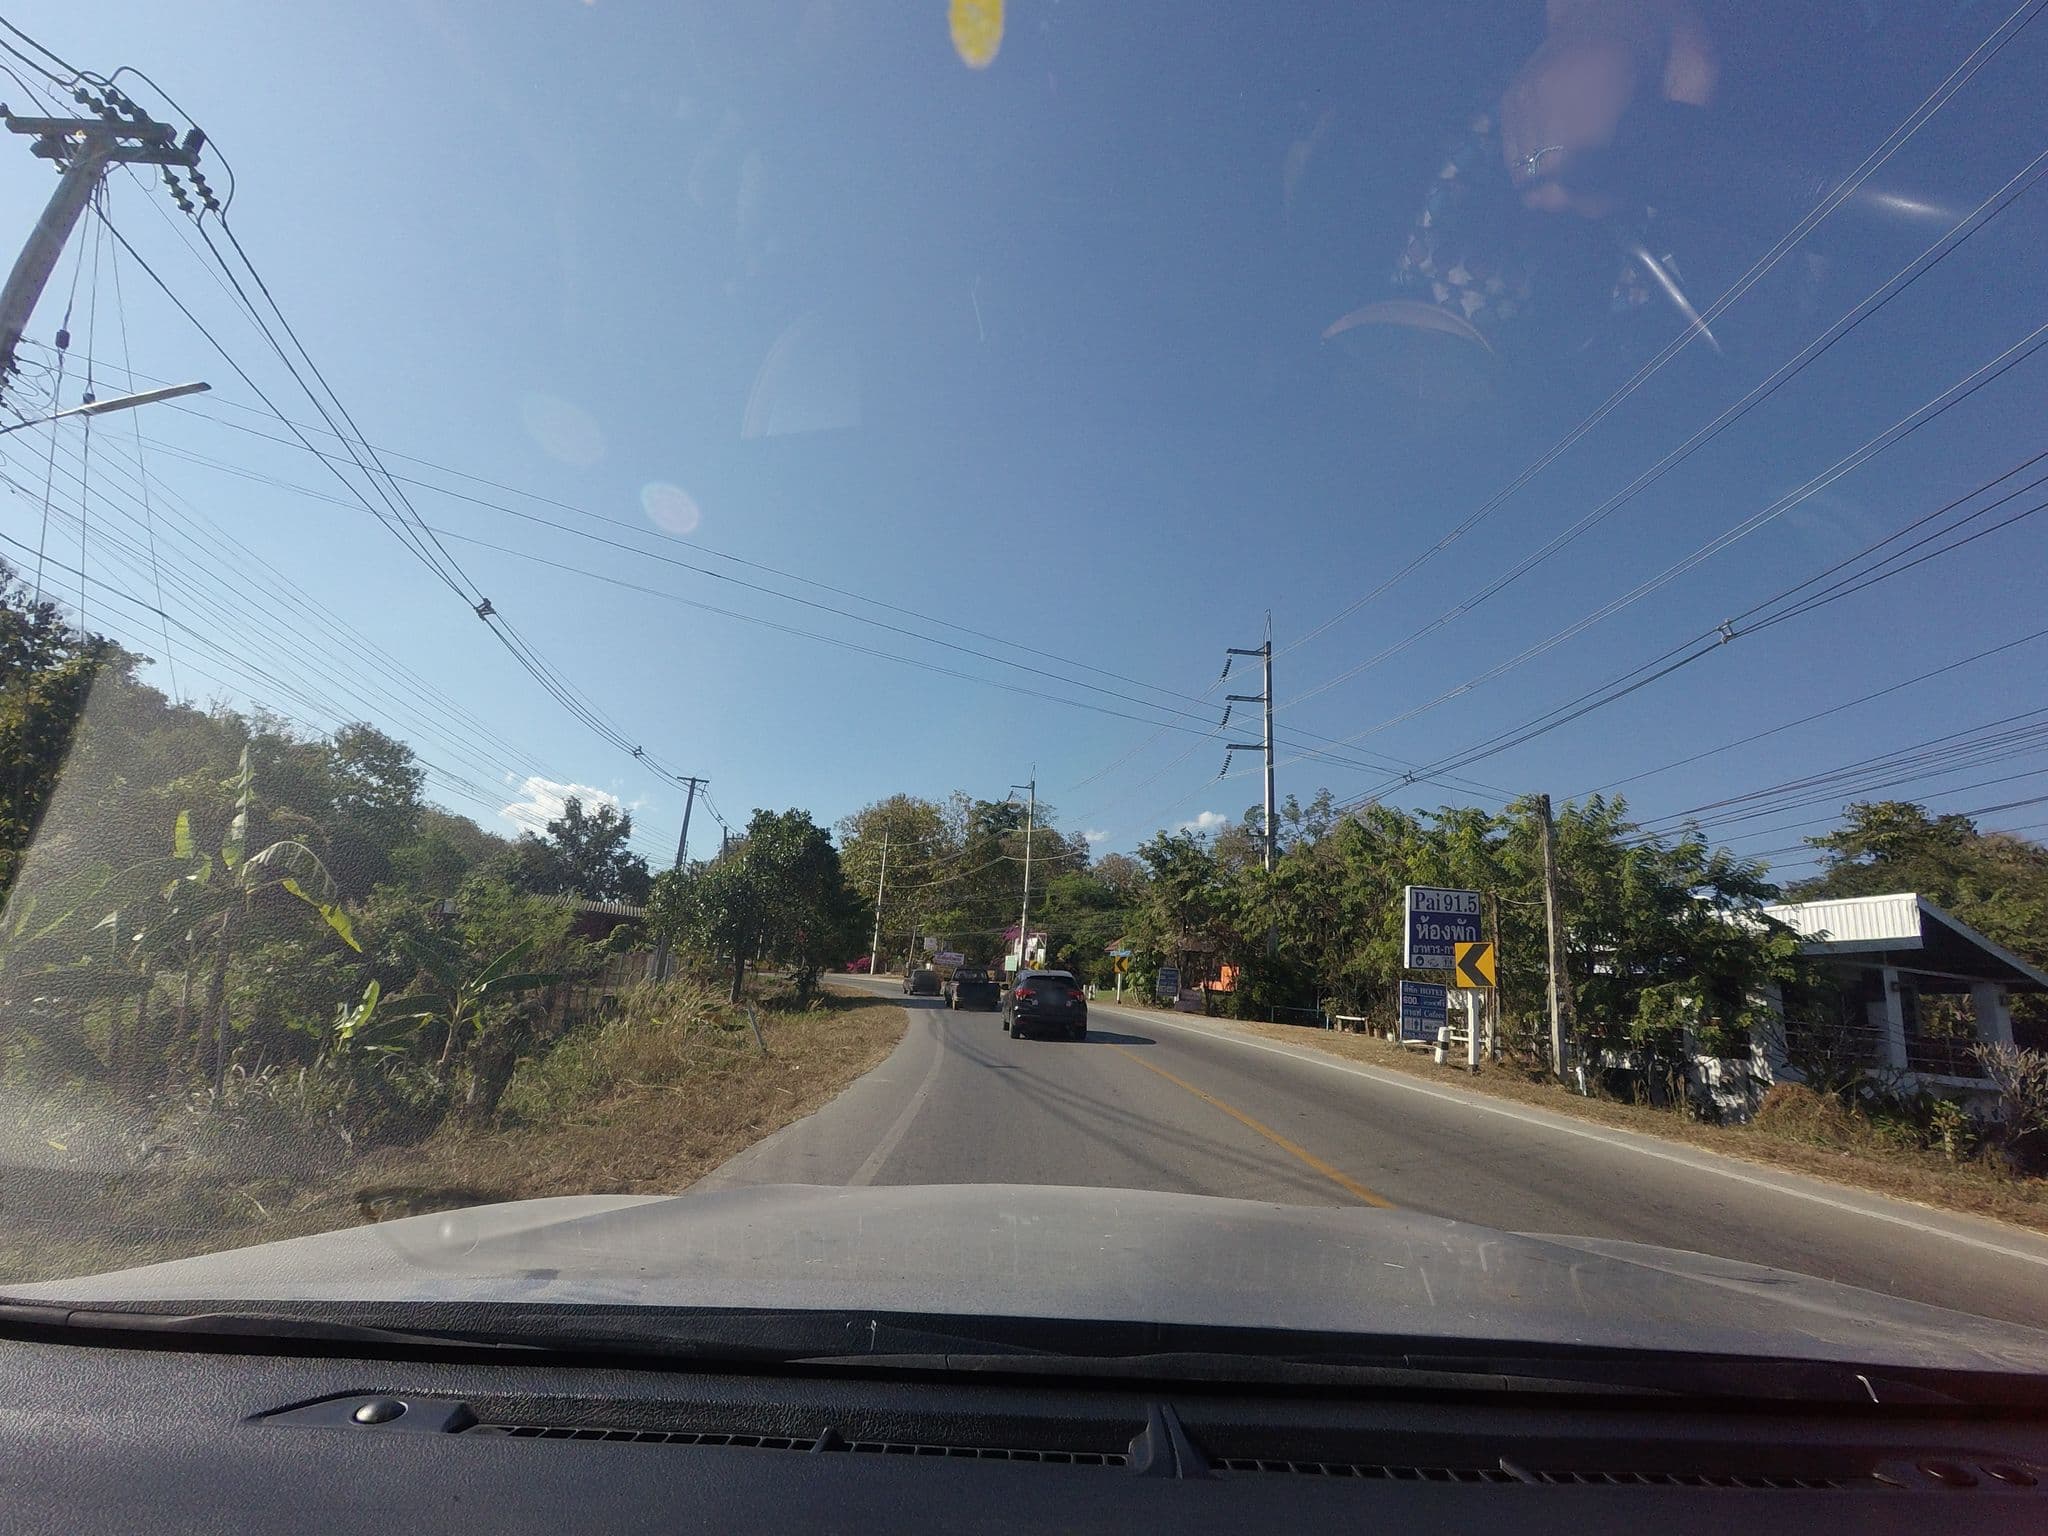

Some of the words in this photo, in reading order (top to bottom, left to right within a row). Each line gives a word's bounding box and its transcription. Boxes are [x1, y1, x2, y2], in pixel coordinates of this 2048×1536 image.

[1415, 892, 1440, 911] Pai
[1443, 894, 1478, 913] 91.5
[1416, 915, 1477, 941] ห้องพัก
[1420, 987, 1445, 997] HOTEL
